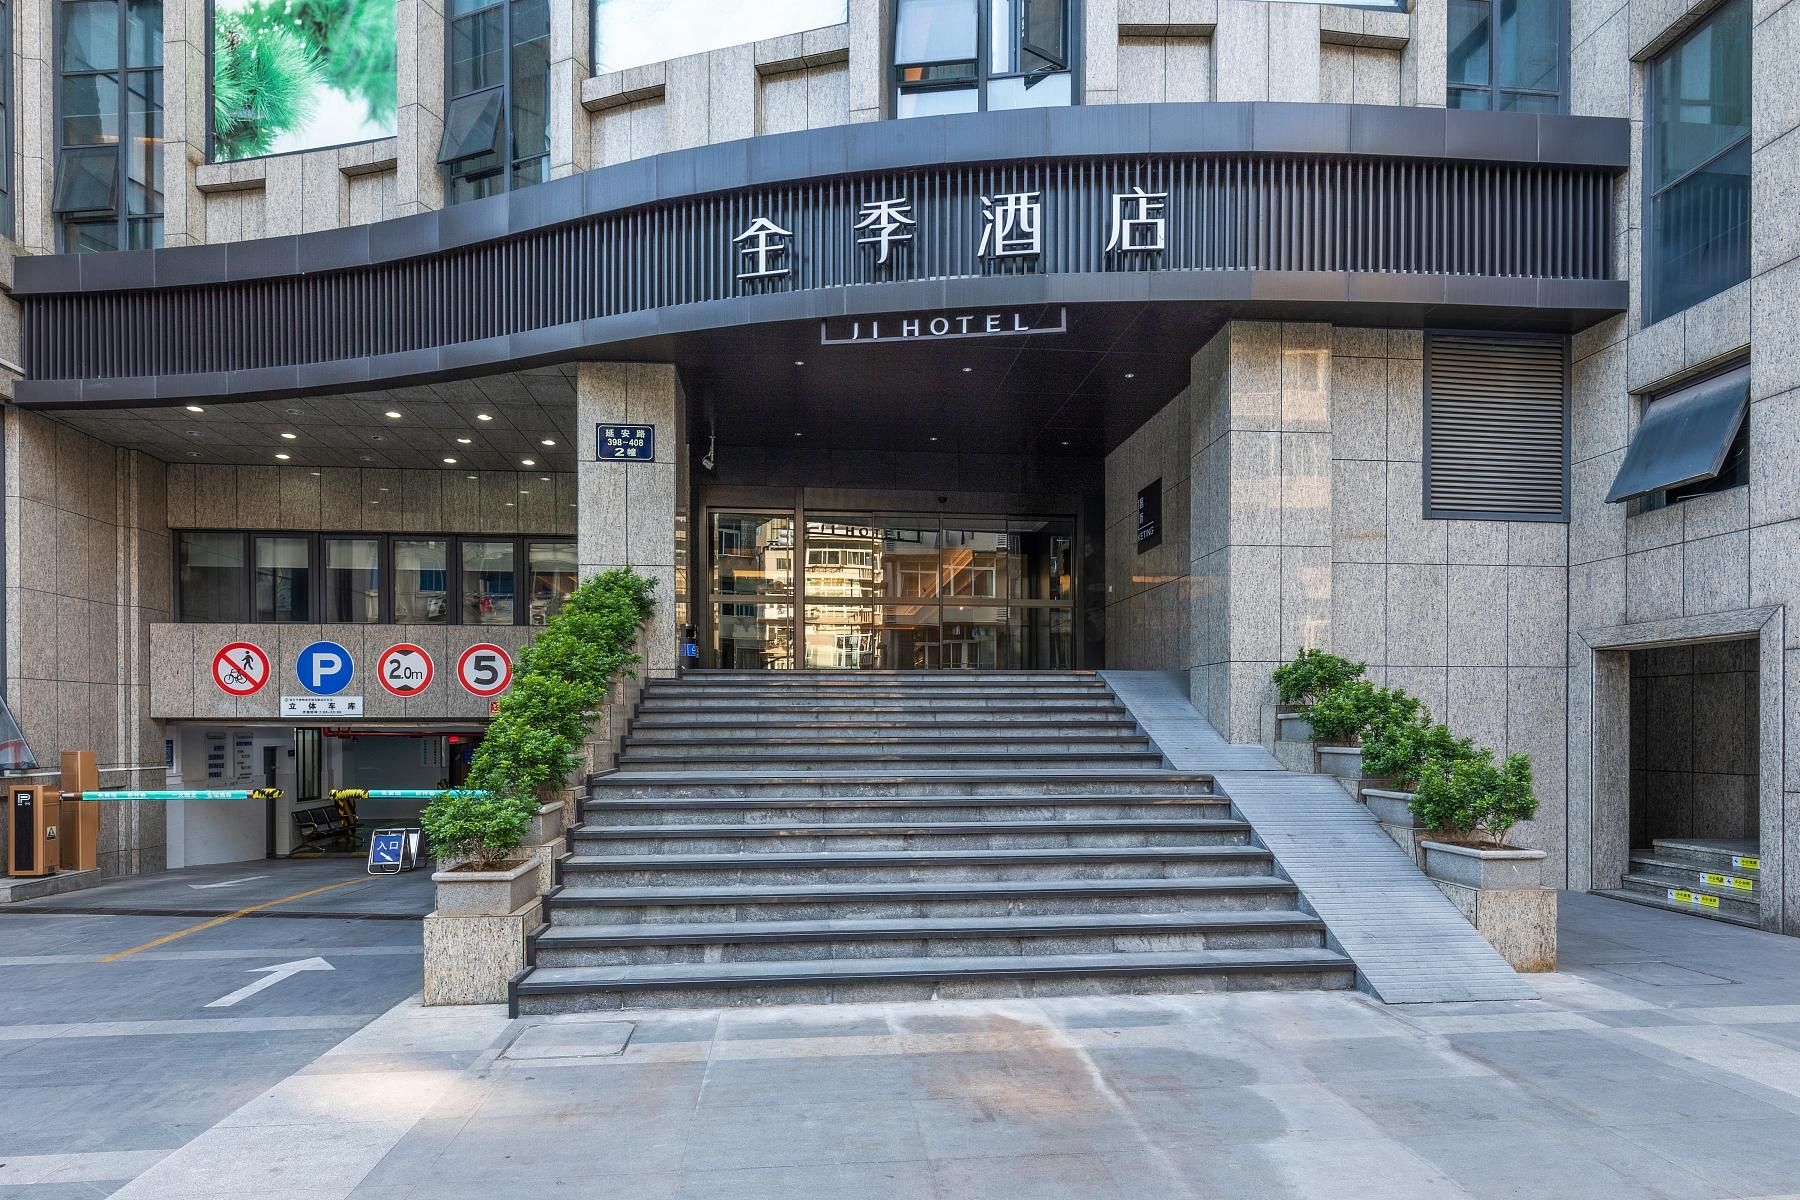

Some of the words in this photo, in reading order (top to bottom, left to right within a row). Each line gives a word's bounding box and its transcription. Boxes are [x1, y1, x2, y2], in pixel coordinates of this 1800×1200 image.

[733, 186, 1168, 279] 全季酒店
[852, 321, 878, 340] JI
[902, 313, 1029, 339] HOTEL
[605, 428, 646, 439] 延安路
[312, 653, 342, 687] P
[389, 658, 423, 680] 2.0m
[473, 655, 499, 685] 5
[288, 702, 356, 711] 立体车库
[376, 841, 399, 851] 入口
